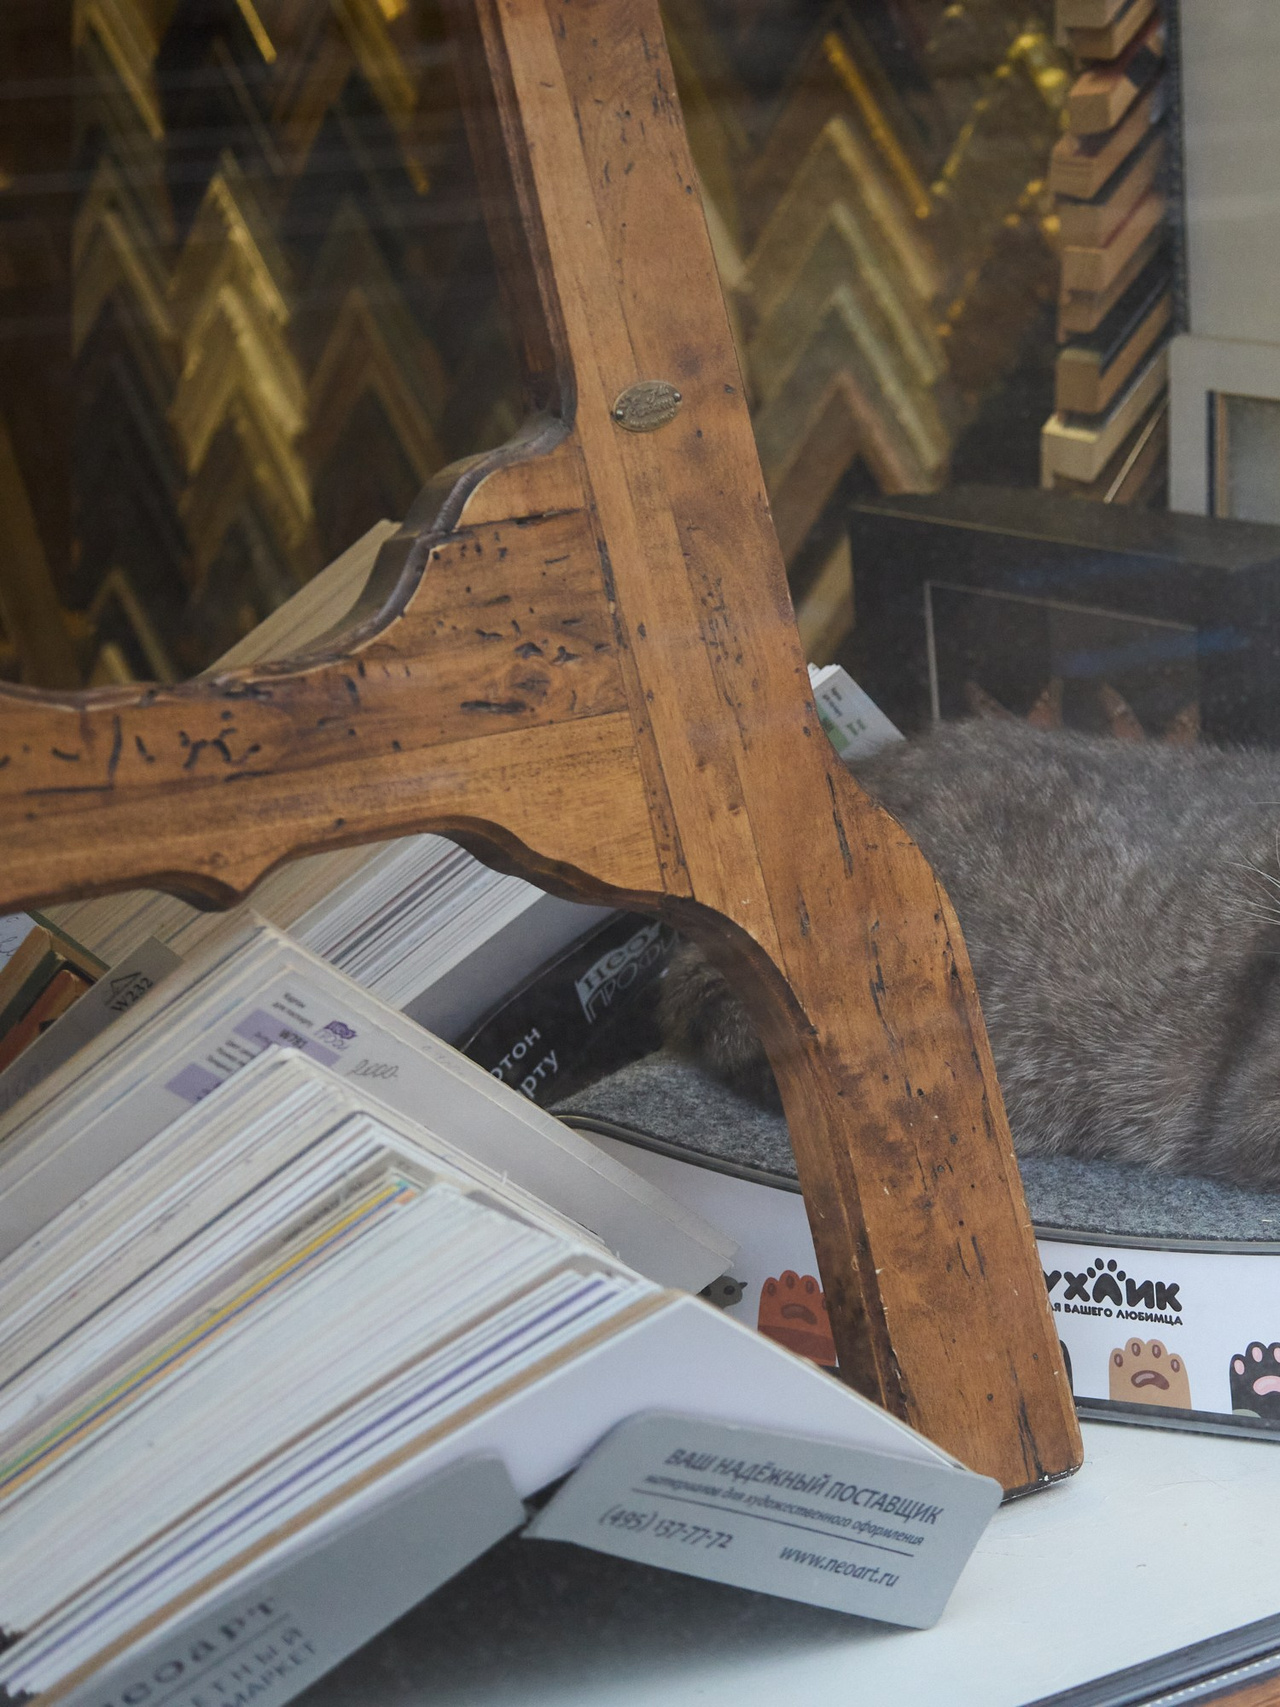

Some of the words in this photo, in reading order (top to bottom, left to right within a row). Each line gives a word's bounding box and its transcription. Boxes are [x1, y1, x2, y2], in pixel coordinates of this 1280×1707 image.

[516, 1050, 559, 1099] рту
[1064, 1303, 1113, 1318] ВАШЕГО
[1116, 1309, 1184, 1326] ЛЮБИМЦА
[664, 1448, 718, 1471] ВАШ
[713, 1457, 833, 1497] НАДЁЖНЫЙ
[824, 1480, 945, 1525] ПОСТАВЩИК
[744, 1492, 852, 1528] художественного
[850, 1519, 925, 1546] оформления
[779, 1546, 900, 1588] www.neoart.ru
